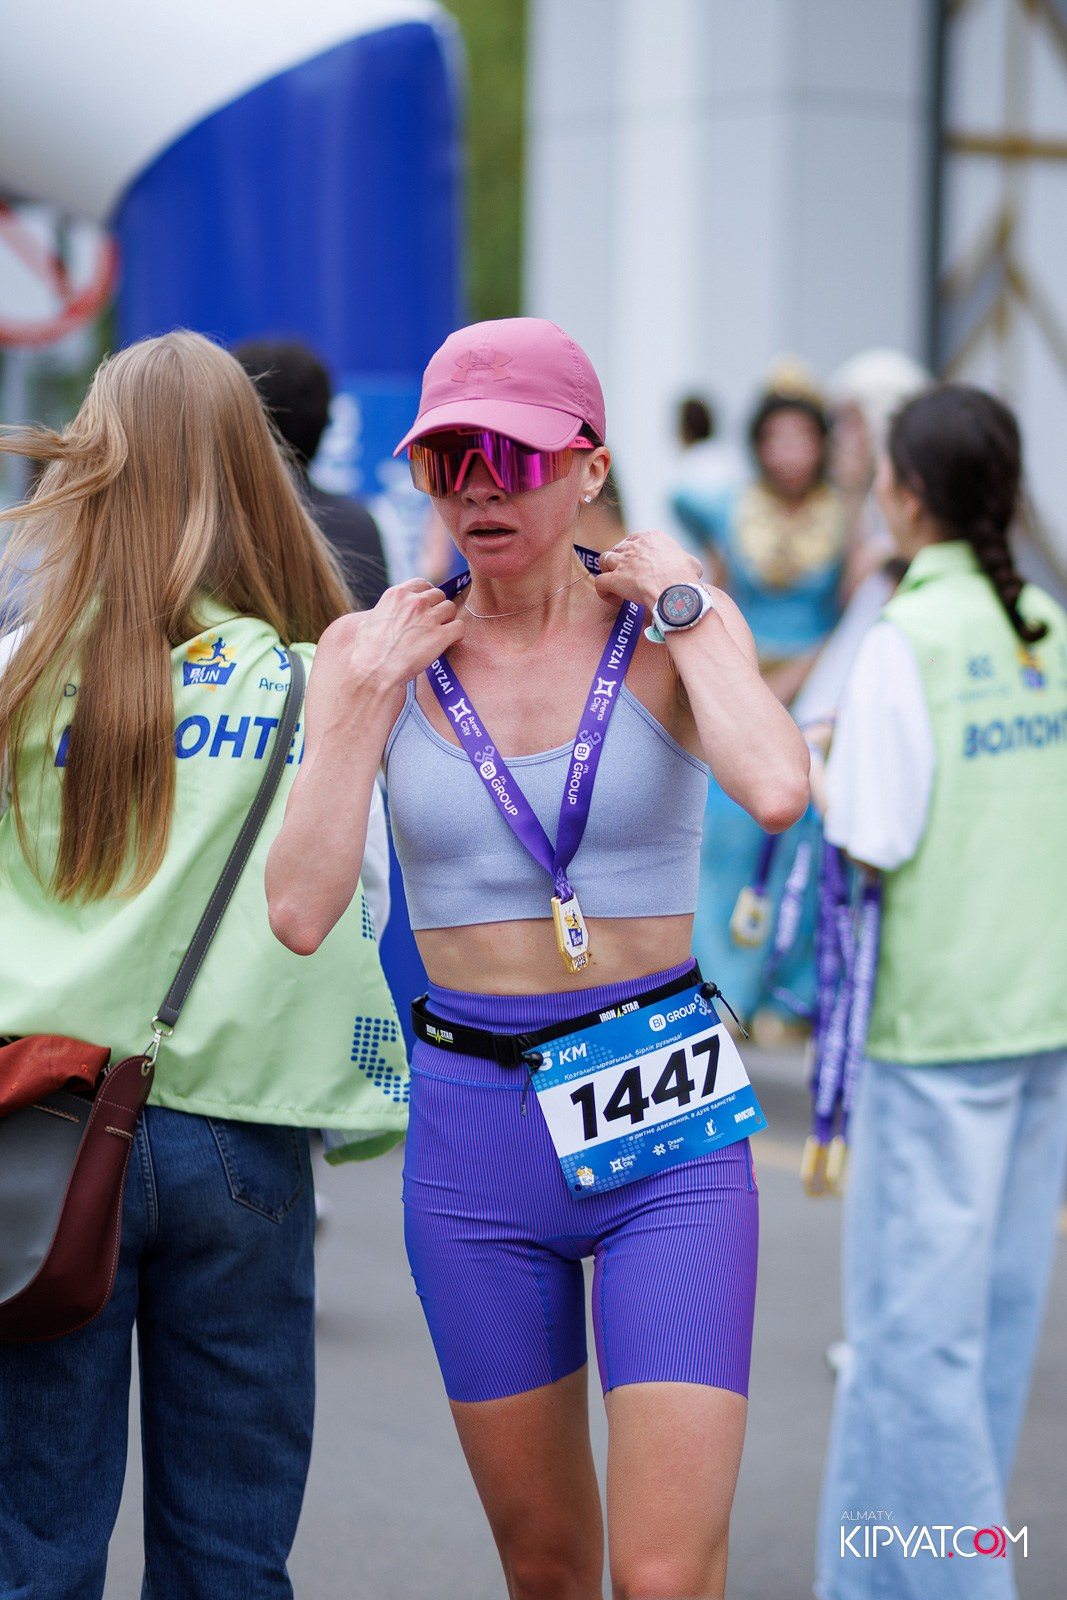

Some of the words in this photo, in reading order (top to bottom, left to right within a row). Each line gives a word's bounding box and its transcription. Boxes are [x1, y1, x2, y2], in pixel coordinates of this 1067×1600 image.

[628, 601, 639, 616] BI
[607, 614, 635, 670] JULDYZAI
[258, 677, 291, 692] Aren
[431, 659, 455, 695] DYZAI
[590, 697, 601, 713] City
[598, 698, 610, 721] Arena
[460, 720, 471, 736] City
[467, 716, 482, 738] Arena
[577, 746, 587, 758] BI
[482, 764, 494, 777] BI
[491, 778, 519, 816] GROUP
[567, 762, 584, 805] GROUP
[599, 1009, 617, 1023] IRON
[621, 1000, 640, 1015] STAR
[666, 1003, 697, 1023] GROUP
[426, 1023, 436, 1035] IRON
[440, 1029, 454, 1041] STAR
[538, 1051, 553, 1071] 5
[559, 1043, 587, 1065] KM
[569, 1034, 720, 1141] 1447
[635, 1128, 655, 1140] ритме
[696, 1106, 710, 1117] духе
